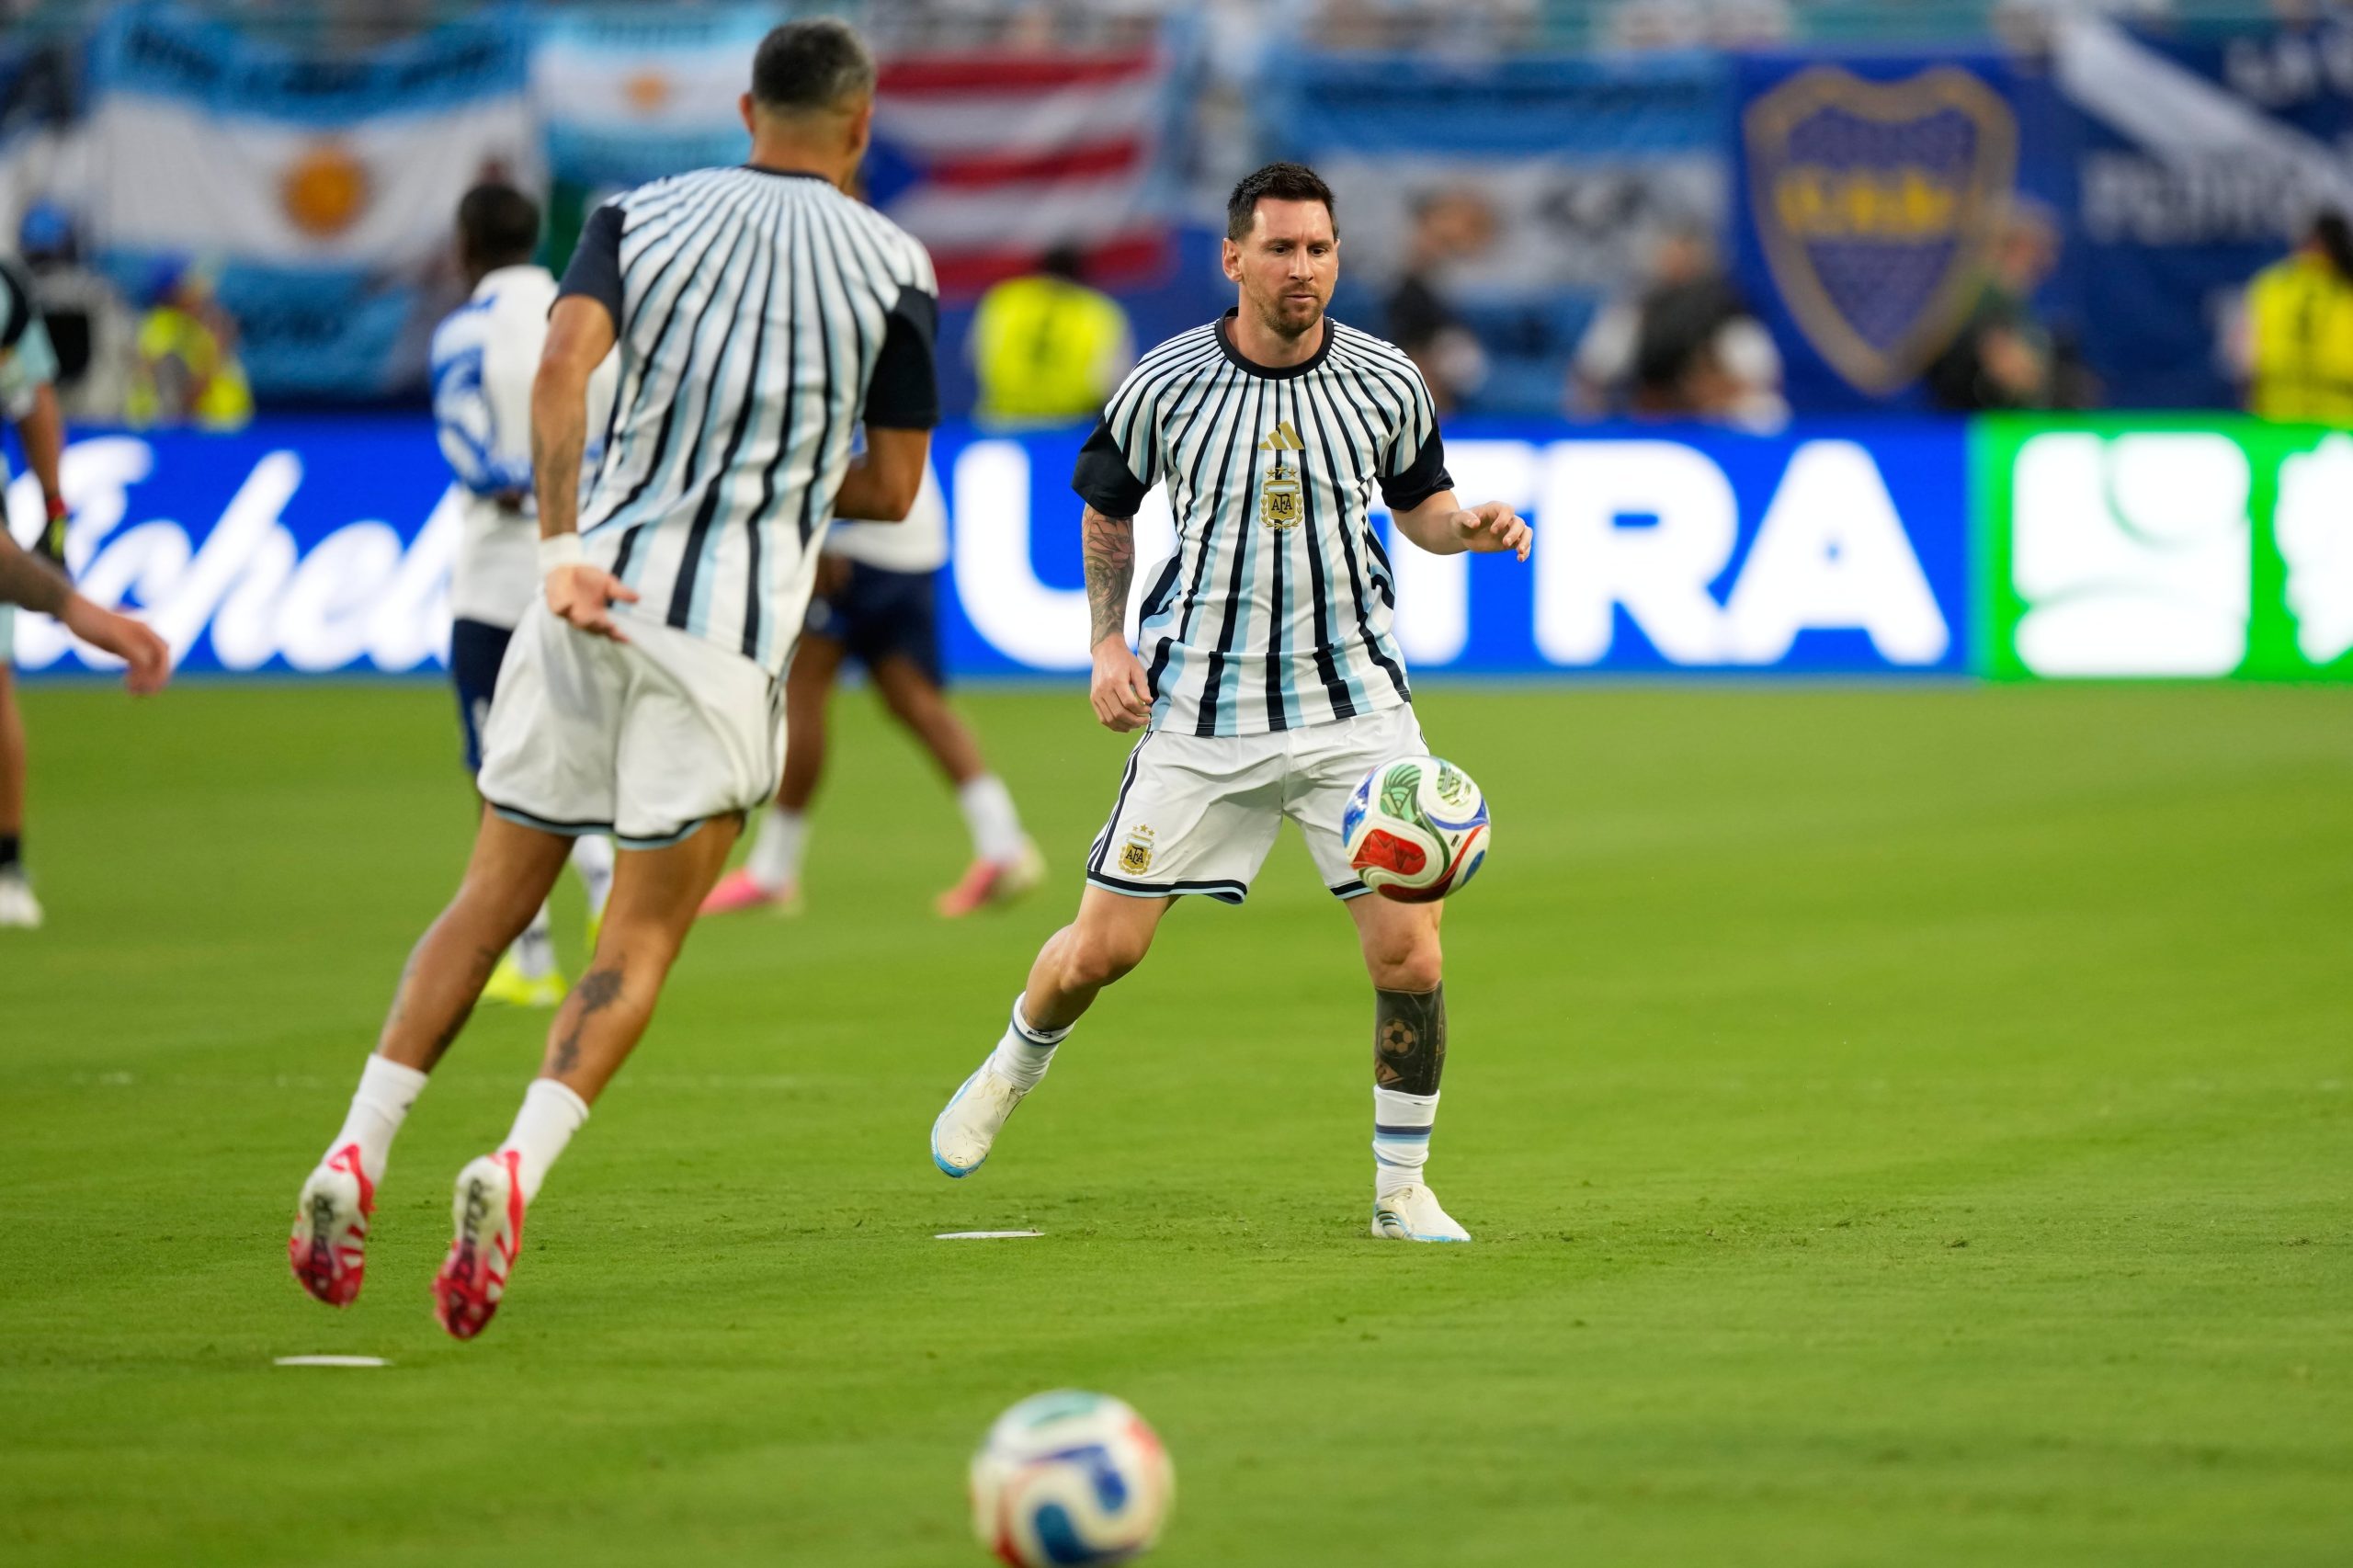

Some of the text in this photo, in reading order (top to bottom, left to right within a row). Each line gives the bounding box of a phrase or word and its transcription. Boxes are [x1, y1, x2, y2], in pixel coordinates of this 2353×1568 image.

[1272, 494, 1293, 515] AFA
[954, 441, 1950, 669] UTRA
[1126, 846, 1144, 865] AFA
